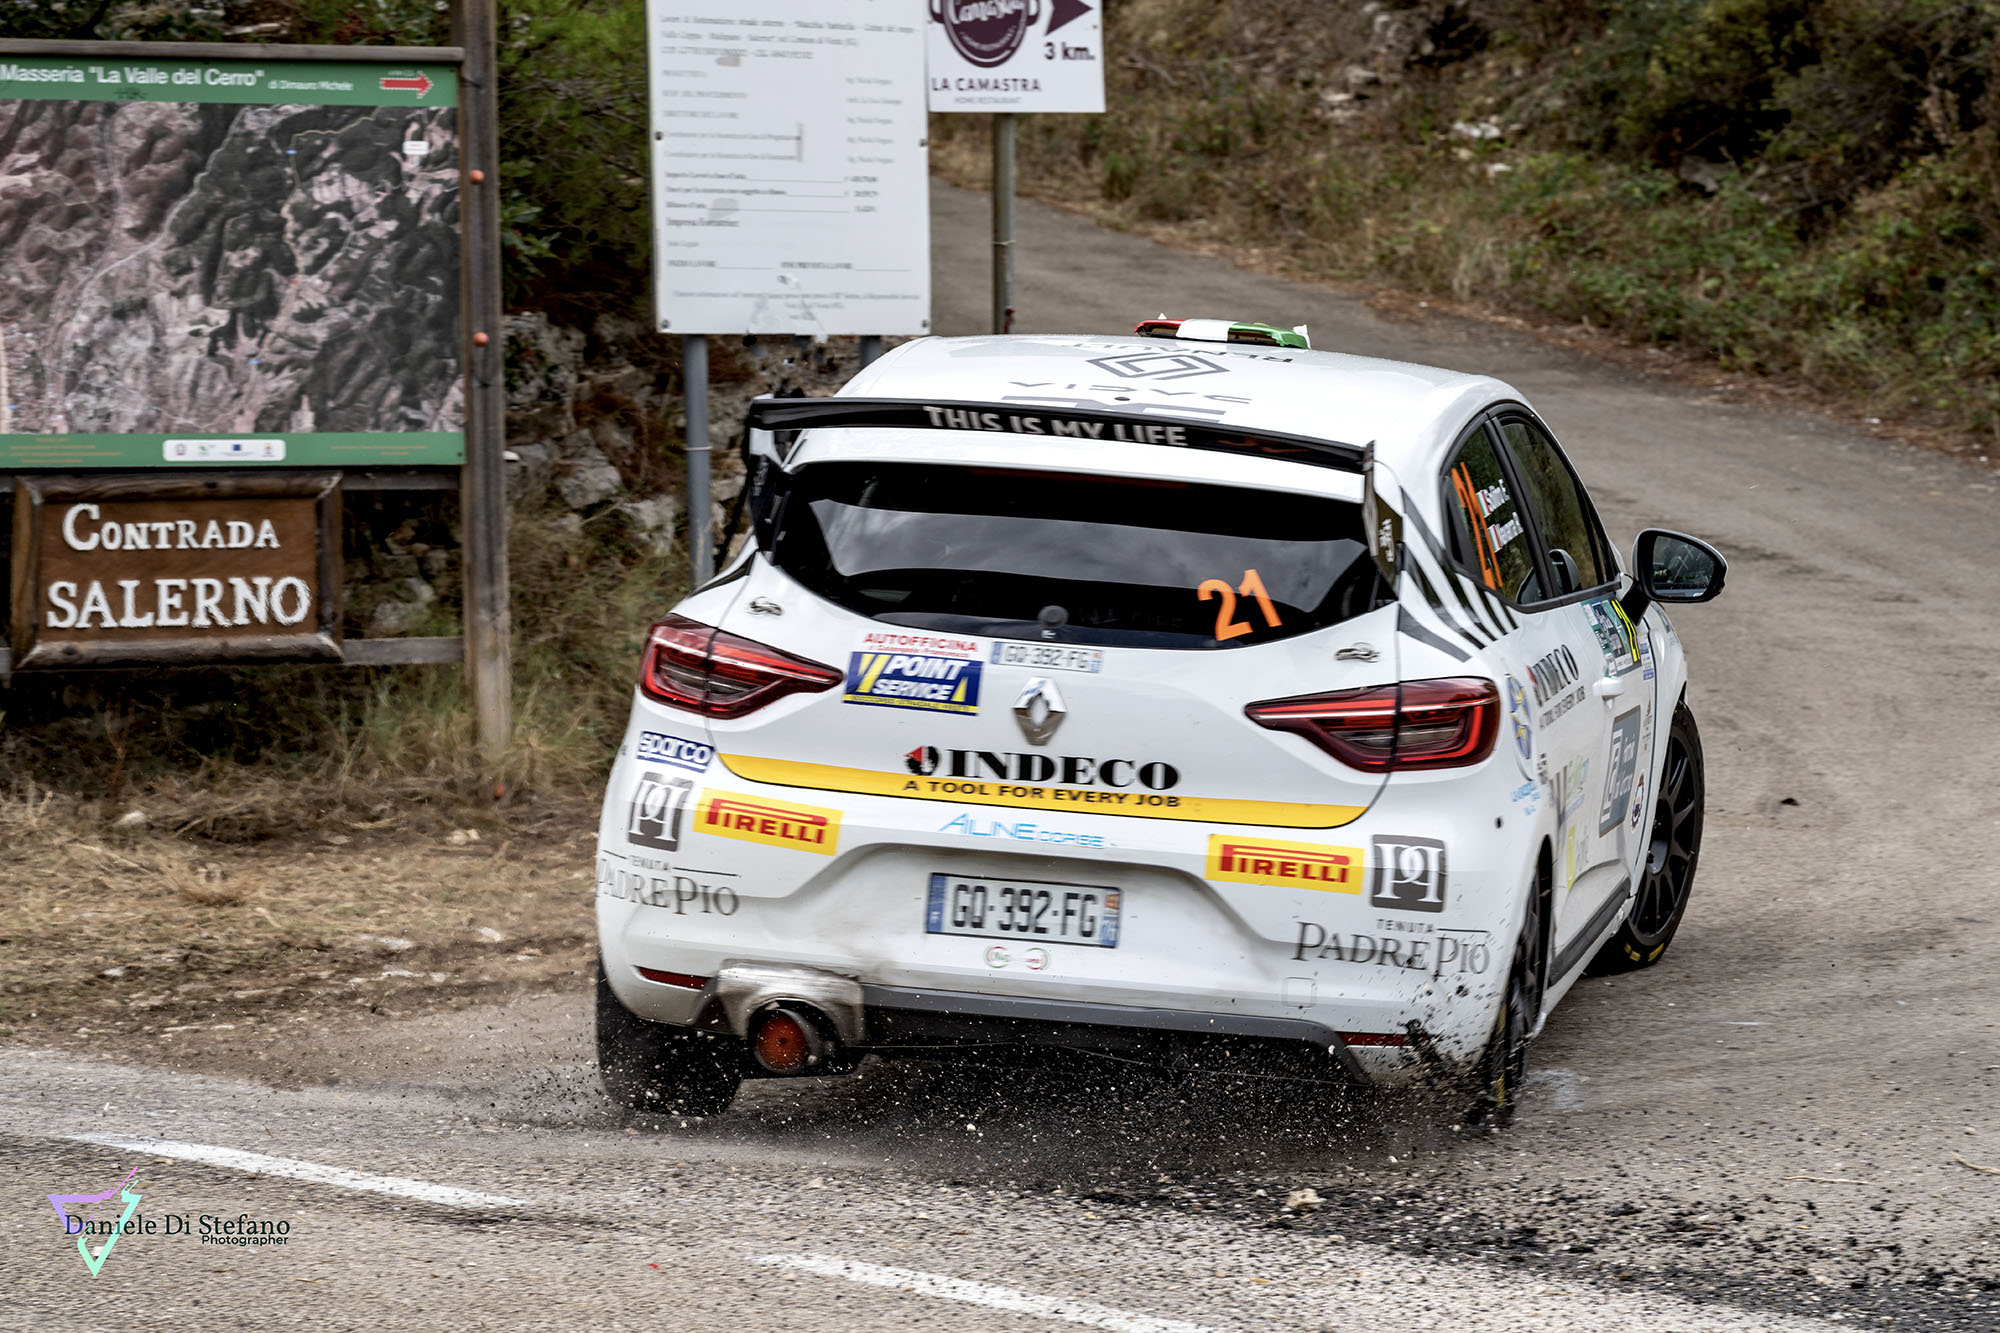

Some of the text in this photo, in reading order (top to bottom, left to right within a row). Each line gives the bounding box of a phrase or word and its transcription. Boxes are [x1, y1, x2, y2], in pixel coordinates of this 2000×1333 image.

[1044, 42, 1096, 60] 3 km.
[0, 63, 85, 83] Masseria
[124, 66, 169, 85] Valle
[171, 68, 201, 85] del
[204, 67, 265, 86] Cerro"
[931, 77, 1041, 92] LA CAMASTRA
[922, 405, 1189, 447] THIS IS MY LIFE
[46, 576, 312, 629] SALERNO
[1197, 568, 1284, 642] 21
[863, 632, 979, 652] AUTOFFICINA
[883, 655, 970, 681] POINT
[871, 678, 956, 702] SERVICE
[638, 732, 713, 766] sparco
[946, 748, 1181, 791] INDECO
[904, 780, 1181, 807] A TOOL FOR EVERY JOB
[706, 798, 828, 845] PIRELLI
[1218, 844, 1350, 883] PIRELLI
[952, 884, 1098, 938] GQ-392-FG
[1376, 919, 1435, 933] TENUTA
